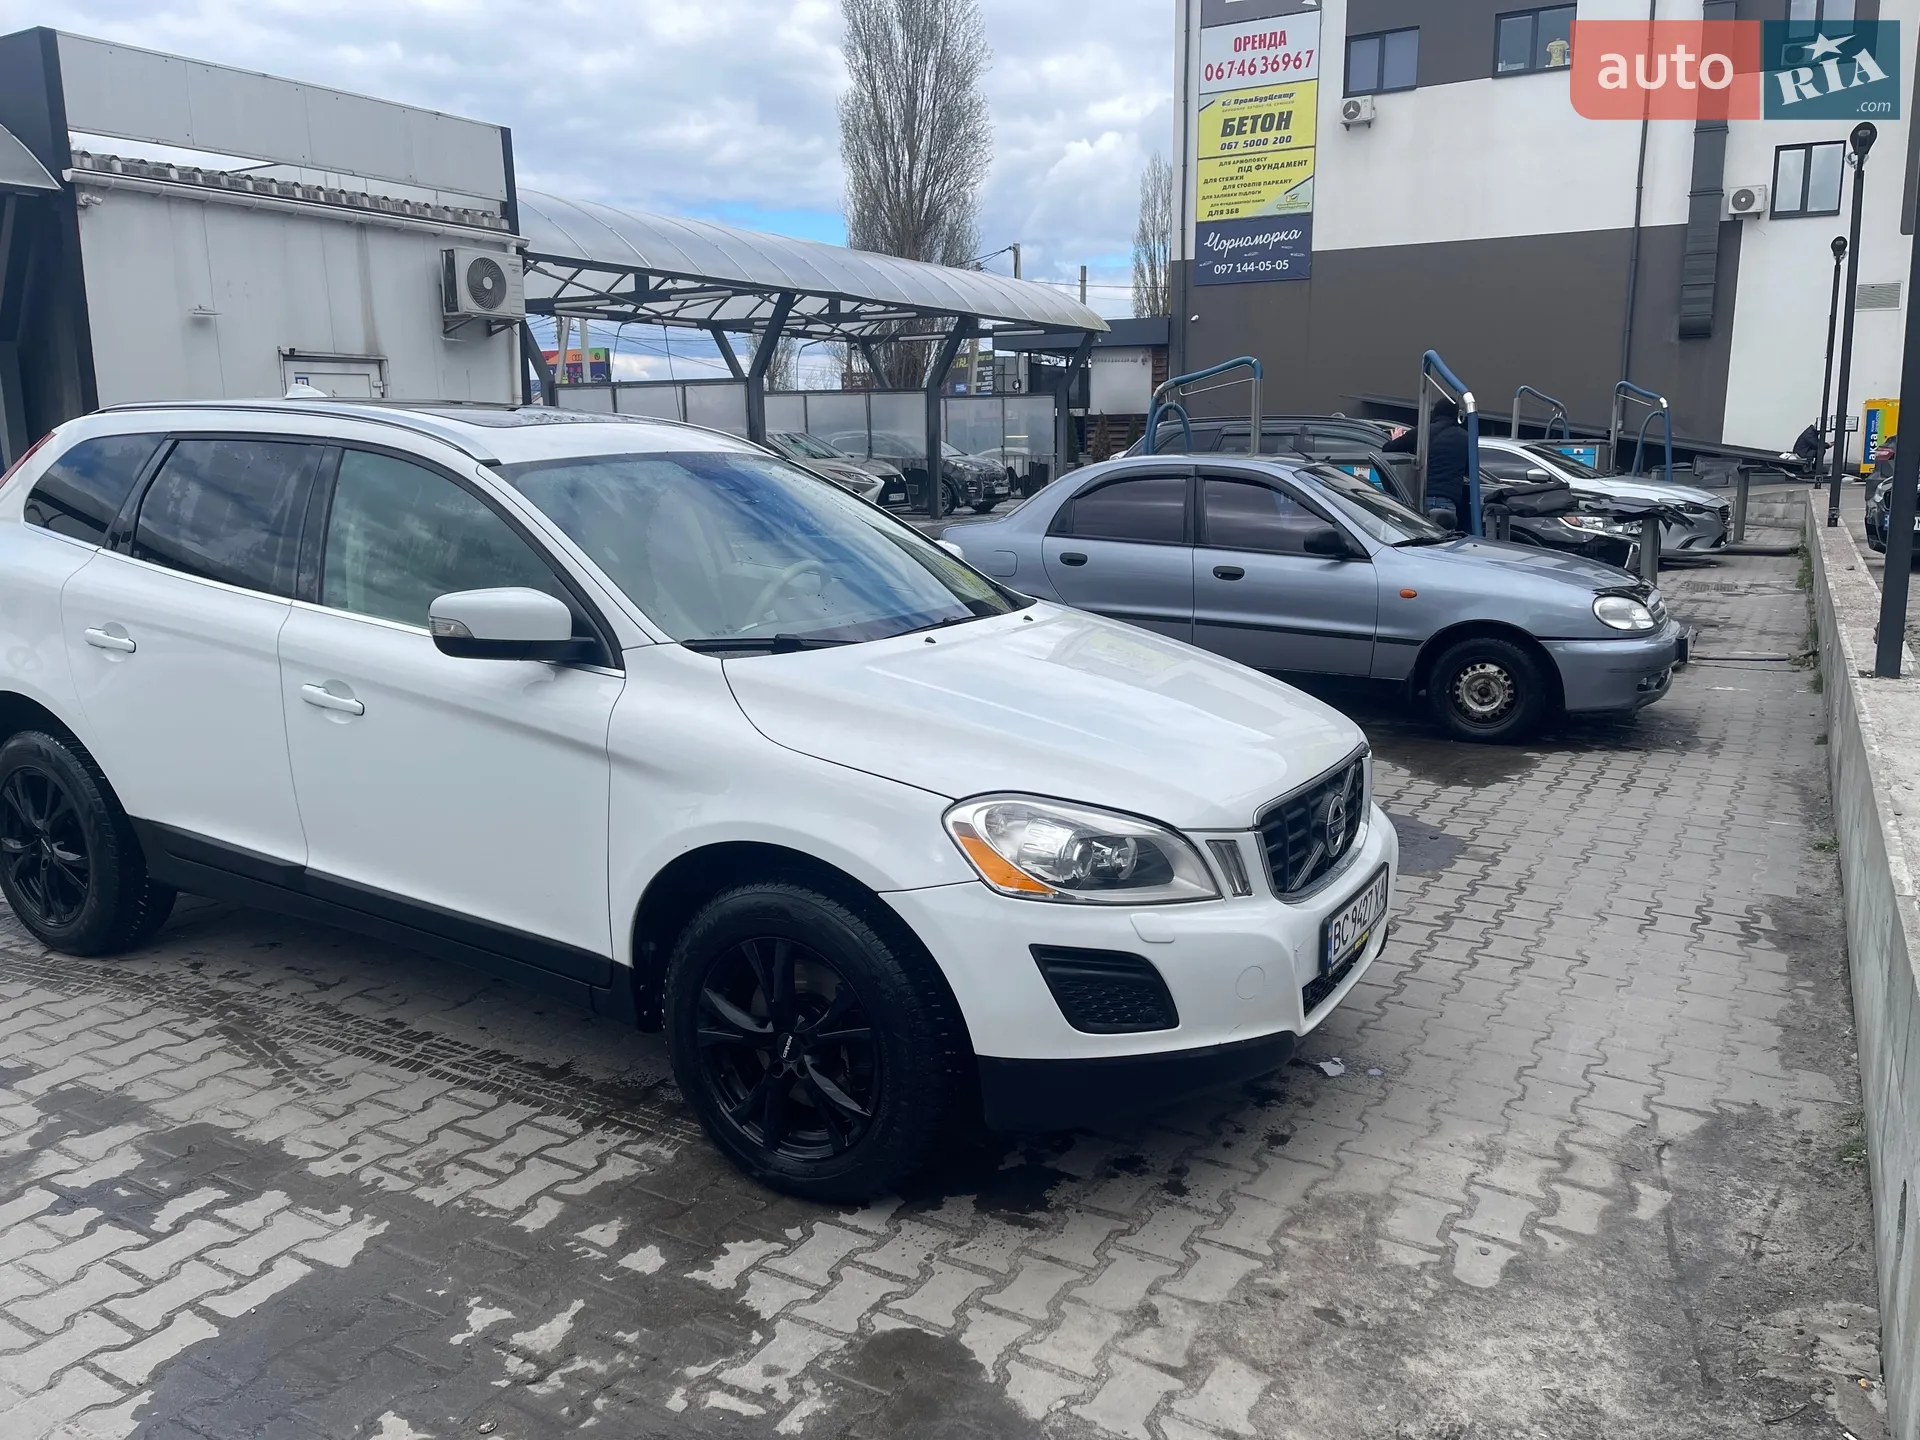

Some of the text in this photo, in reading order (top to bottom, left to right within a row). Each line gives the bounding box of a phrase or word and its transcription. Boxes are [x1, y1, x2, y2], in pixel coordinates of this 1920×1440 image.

[1233, 30, 1287, 53] ОРЕНДА
[1220, 110, 1293, 137] БЕТОН
[1220, 135, 1292, 151] 067 5000 200
[1237, 159, 1308, 174] ПІД ФУНДАМЕНТ
[1218, 175, 1244, 183] СТЯЖКИ
[1236, 181, 1262, 189] СТОВПІВ
[1263, 178, 1293, 186] ПАРКАНУ
[1203, 229, 1302, 258] Чорноморка
[1214, 259, 1289, 275] 097 144-05-05
[1351, 888, 1374, 939] 9427
